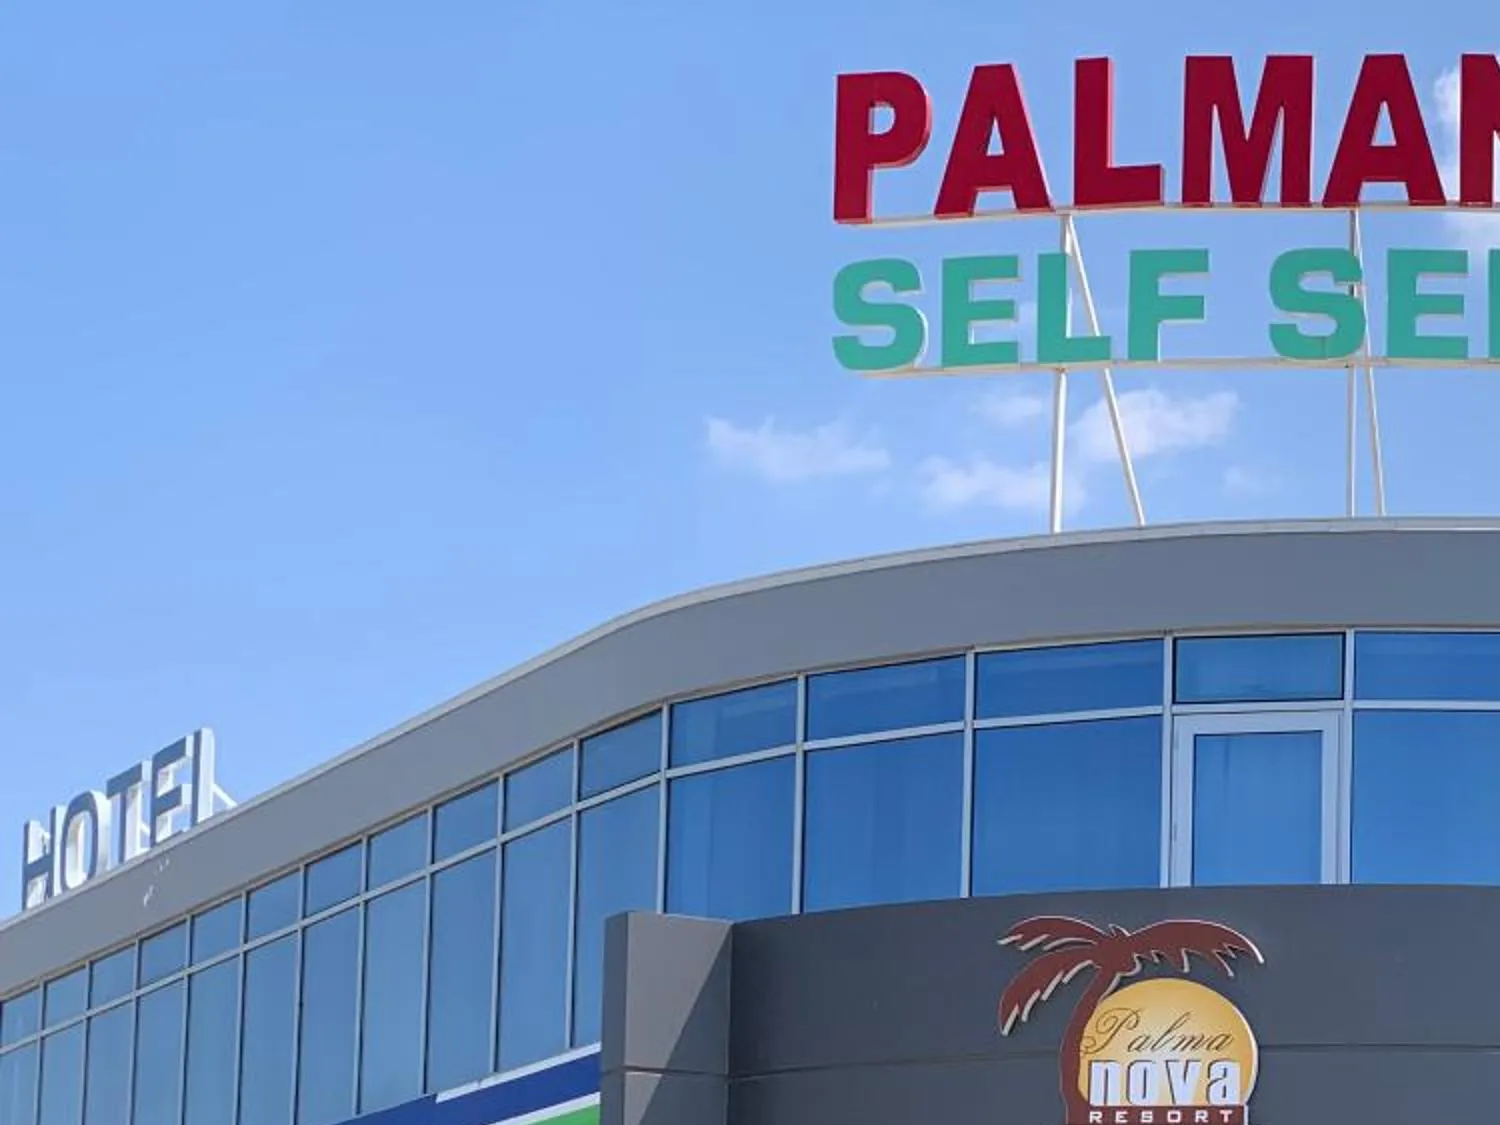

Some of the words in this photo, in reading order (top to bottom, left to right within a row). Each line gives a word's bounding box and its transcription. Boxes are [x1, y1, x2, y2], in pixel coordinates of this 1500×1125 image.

[832, 248, 1210, 372] SELF
[22, 727, 215, 911] HOTEL
[1083, 1007, 1234, 1054] Palma
[1088, 1060, 1241, 1106] nova
[1089, 1110, 1235, 1123] RESORT
